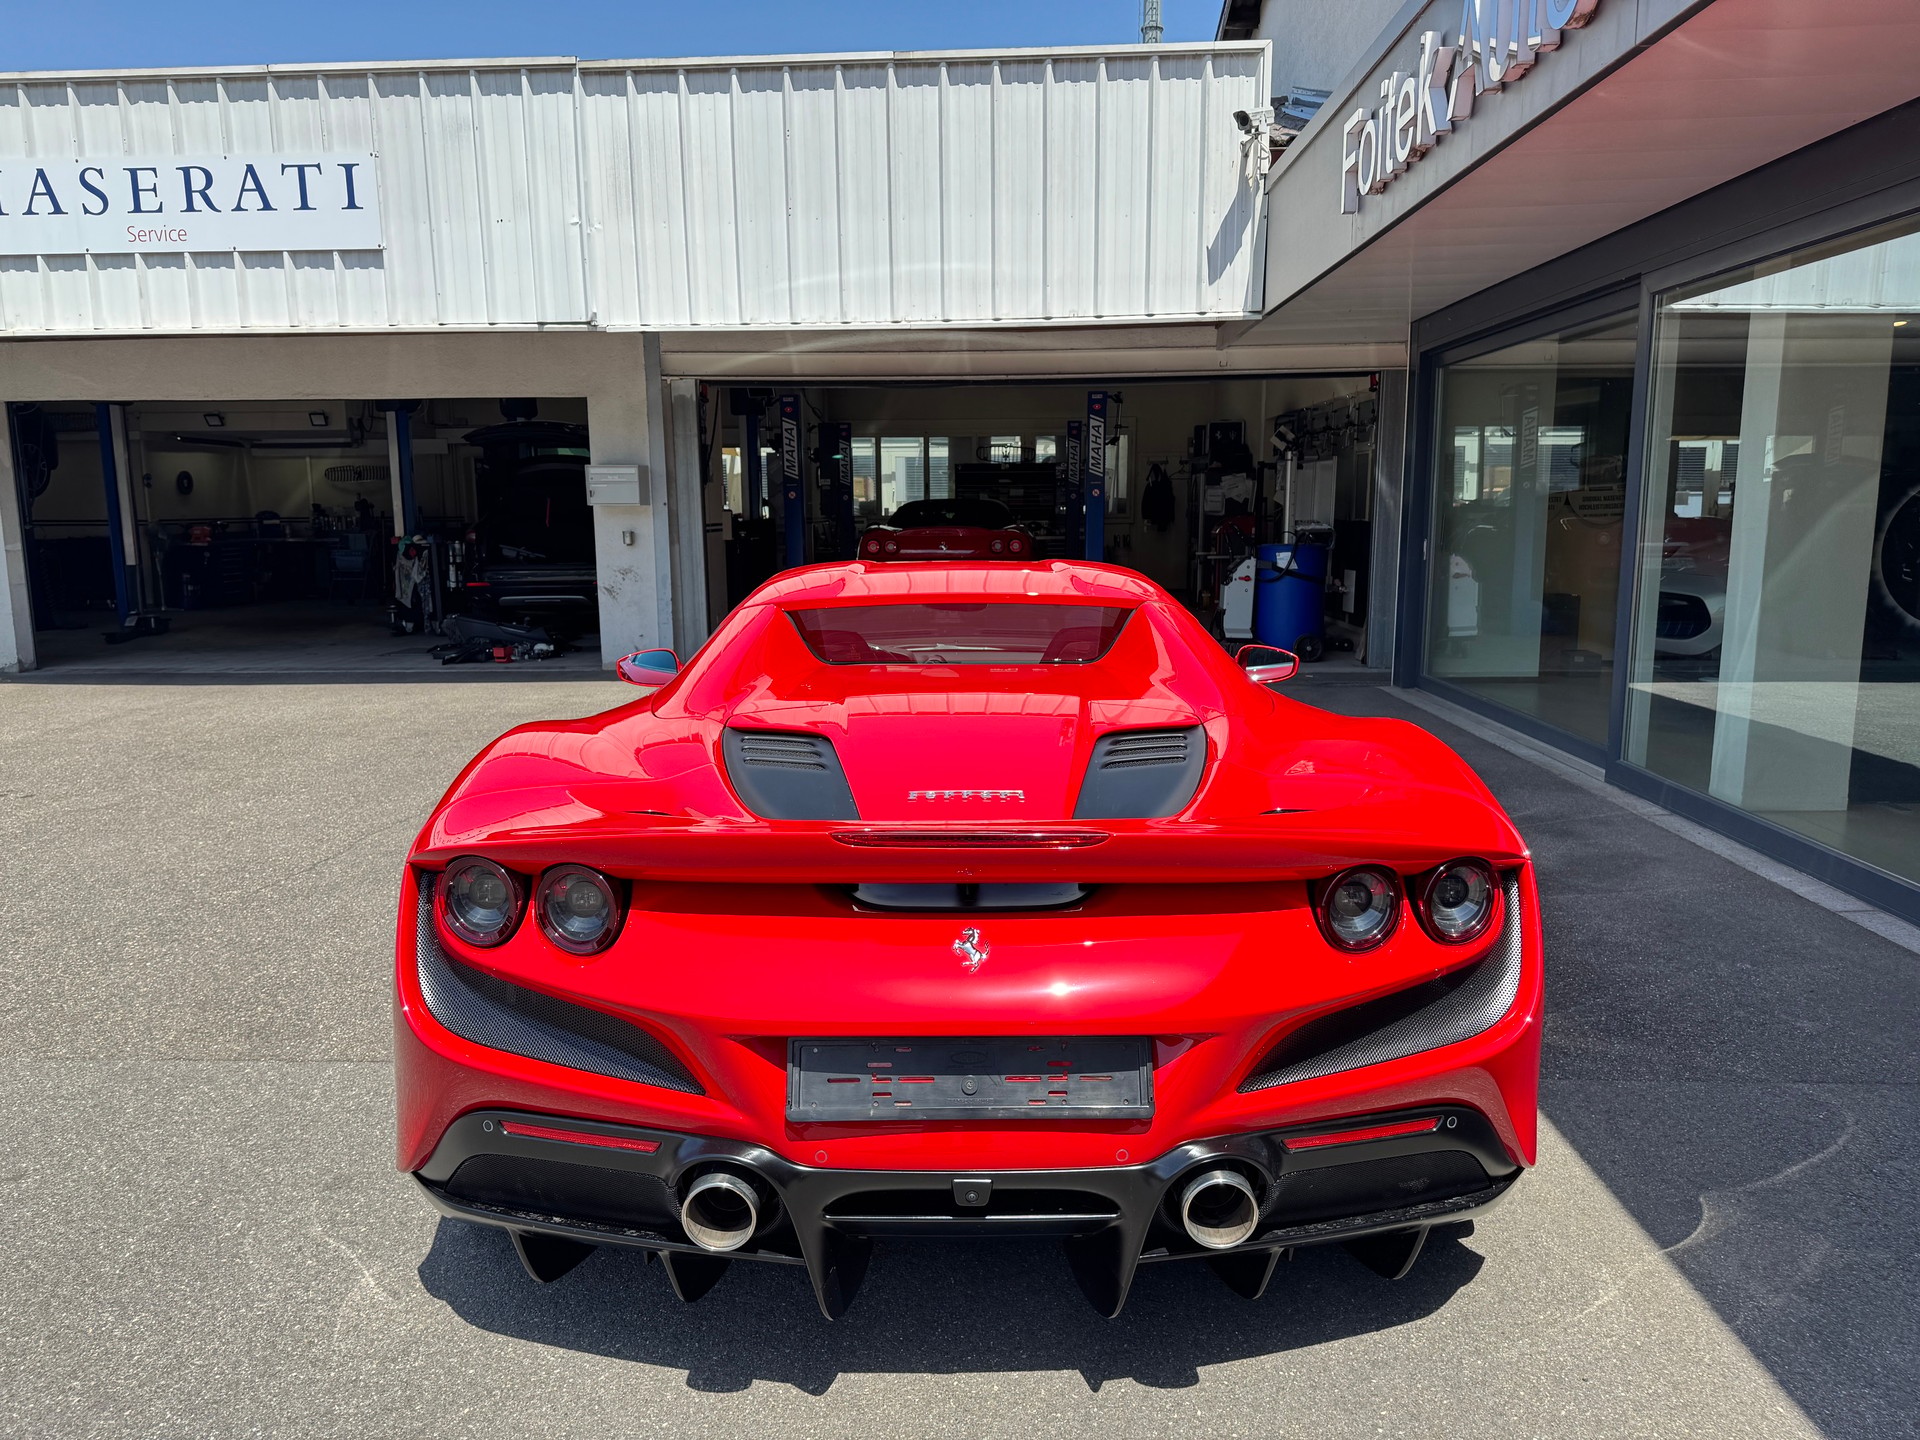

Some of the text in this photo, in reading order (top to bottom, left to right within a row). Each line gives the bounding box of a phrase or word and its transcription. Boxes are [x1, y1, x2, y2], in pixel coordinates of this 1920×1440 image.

[1341, 31, 1452, 214] Foitek
[0, 163, 364, 216] ASERATI
[126, 224, 188, 243] Service
[784, 426, 797, 473] MAHA
[1070, 445, 1079, 481] MAHA
[1090, 424, 1102, 471] MAHA
